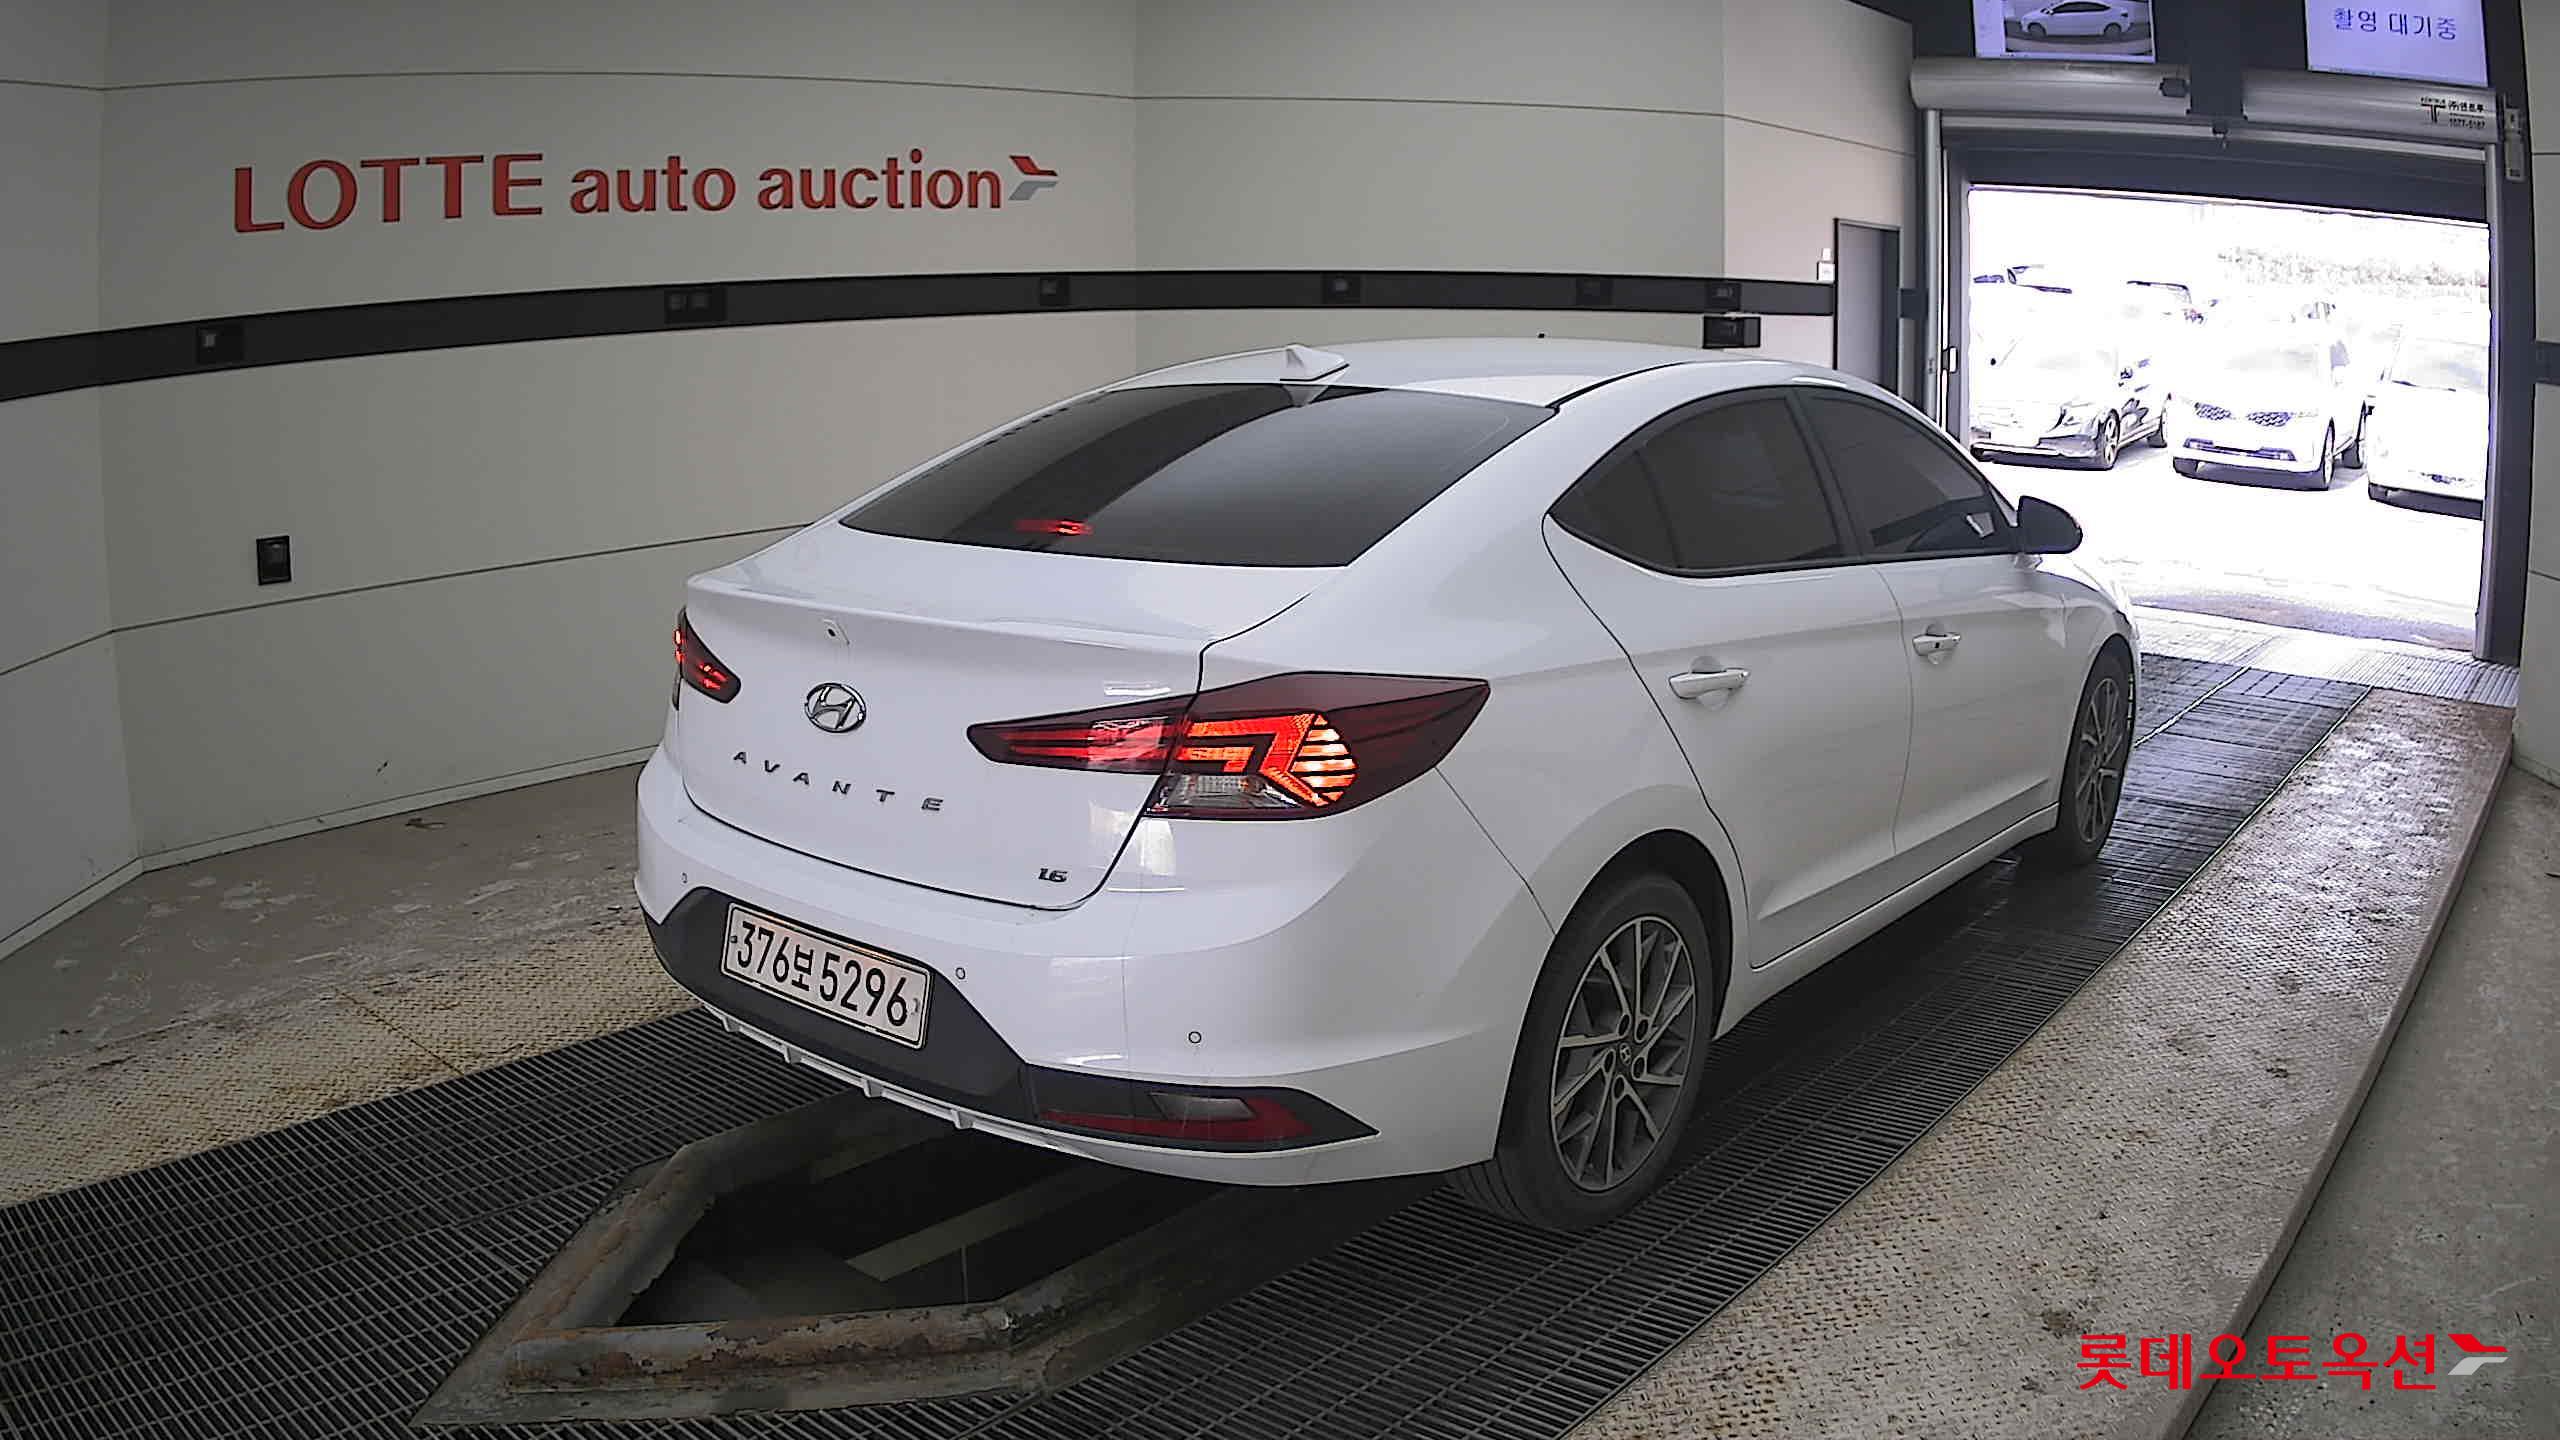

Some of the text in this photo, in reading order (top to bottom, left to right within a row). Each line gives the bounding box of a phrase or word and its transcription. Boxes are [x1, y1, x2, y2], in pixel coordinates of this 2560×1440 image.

[2334, 8, 2457, 41] 촬영 대기중
[234, 149, 1004, 233] LOTTE auto auction
[733, 750, 944, 812] AVANTE
[736, 920, 908, 1027] 376보5296
